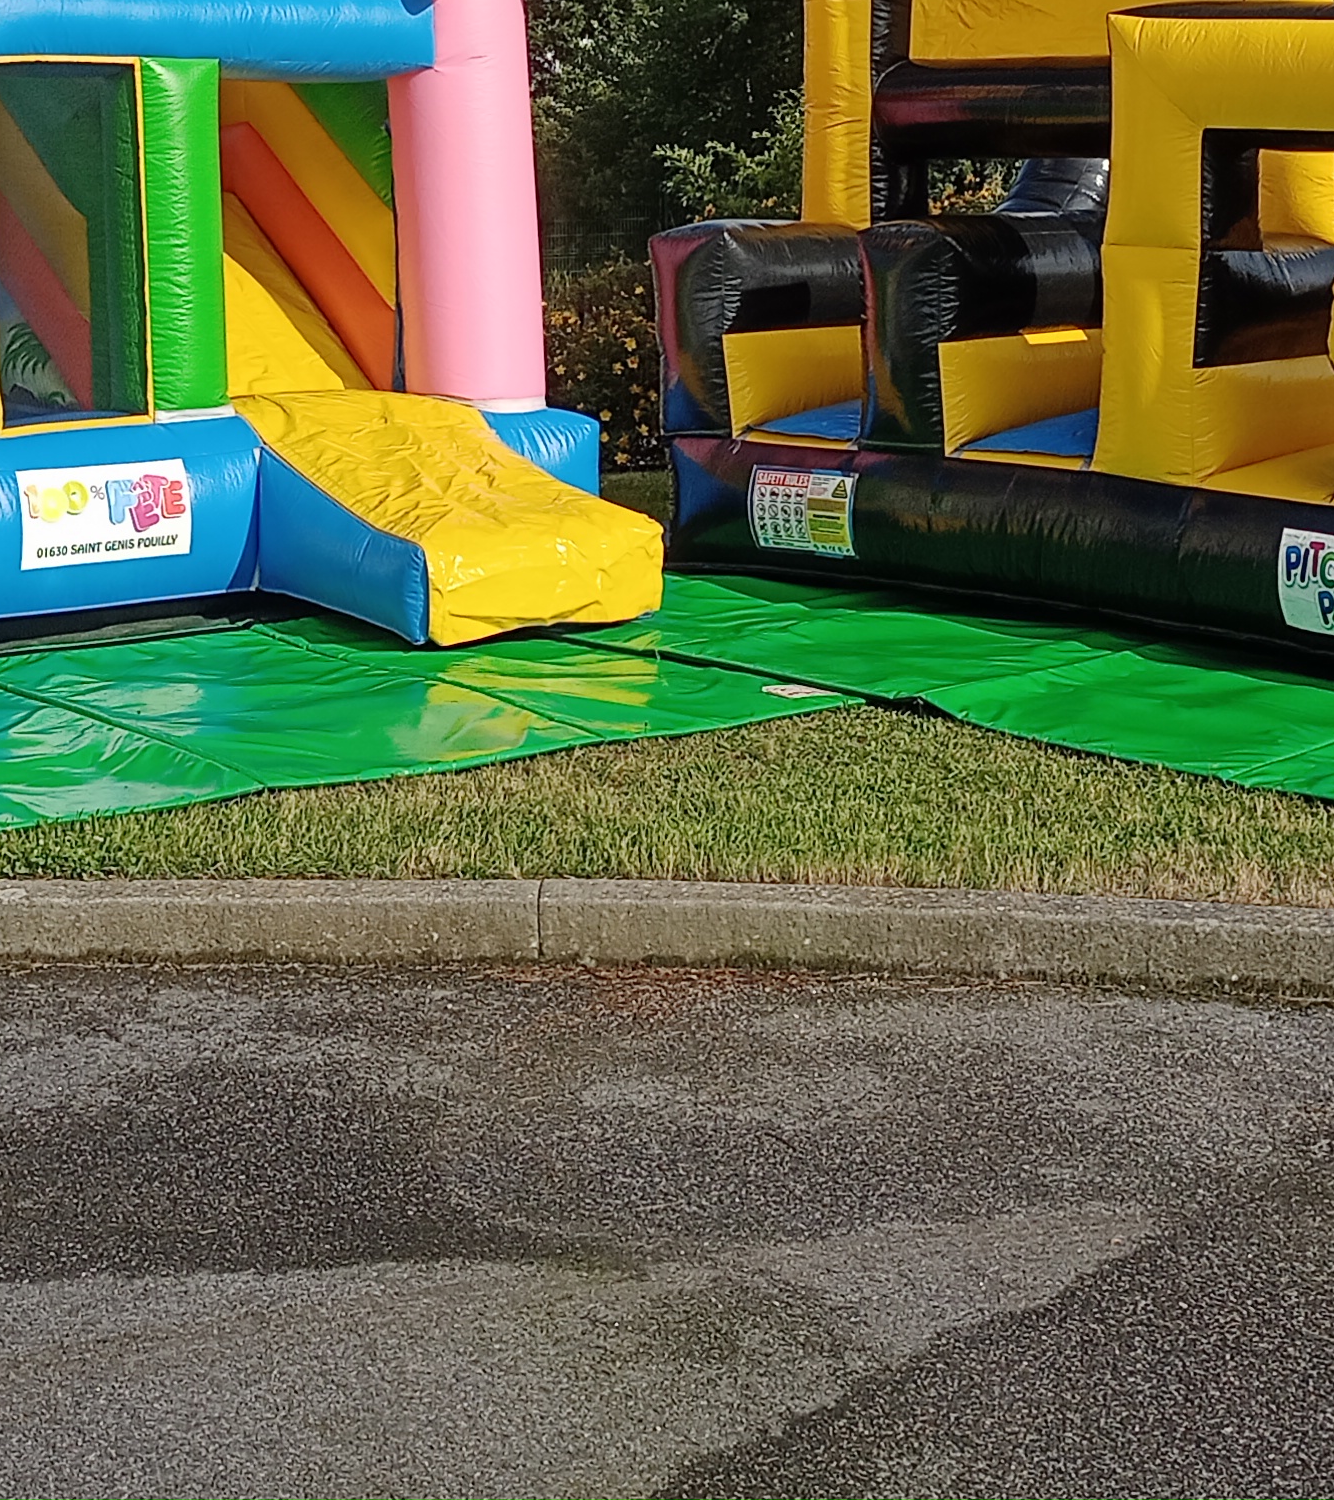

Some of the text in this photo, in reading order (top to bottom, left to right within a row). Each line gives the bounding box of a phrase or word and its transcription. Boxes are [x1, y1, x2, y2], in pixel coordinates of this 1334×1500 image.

[37, 534, 179, 558] 01630 SAINT GENIS POUILLY
